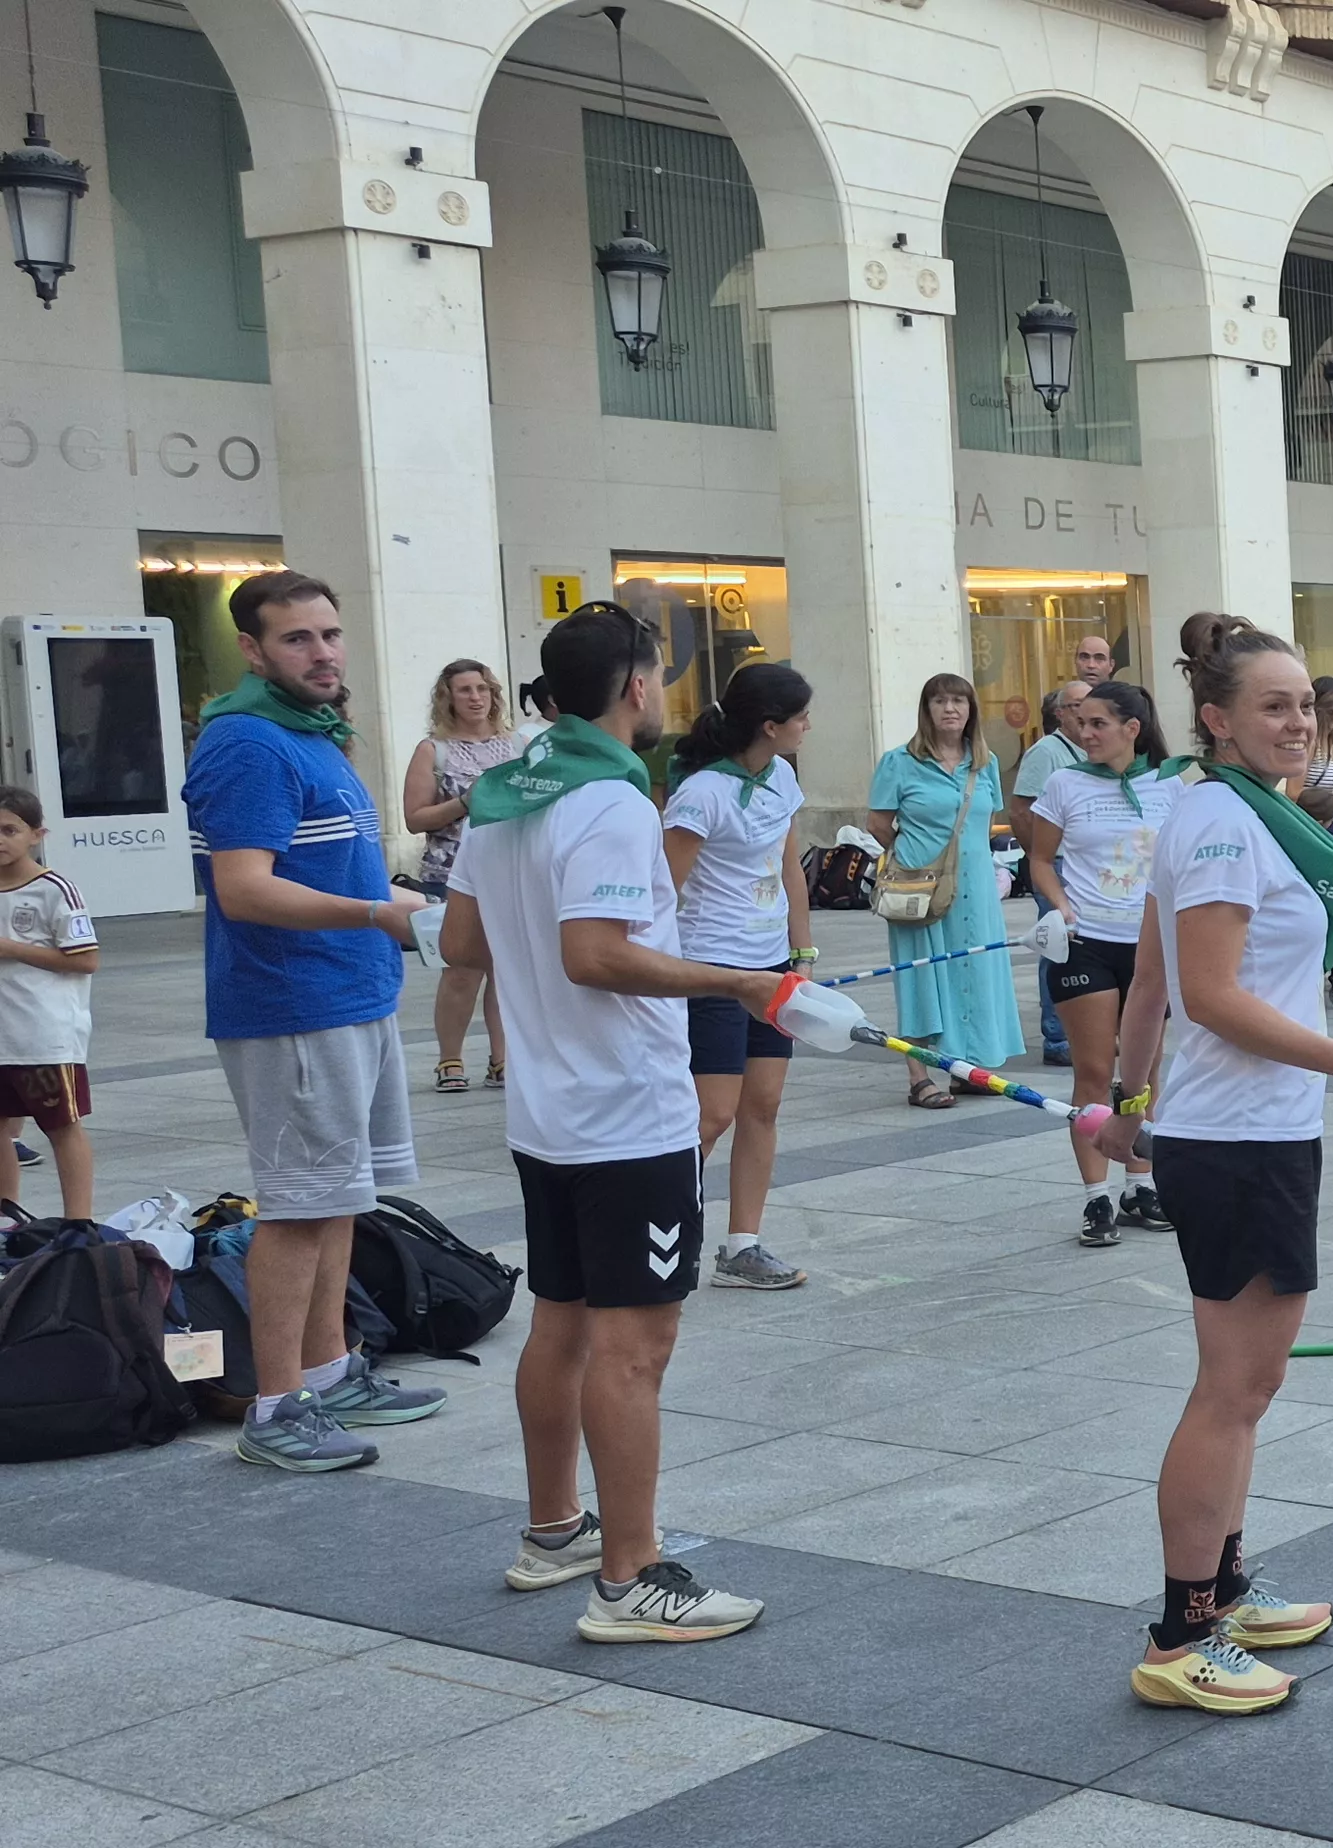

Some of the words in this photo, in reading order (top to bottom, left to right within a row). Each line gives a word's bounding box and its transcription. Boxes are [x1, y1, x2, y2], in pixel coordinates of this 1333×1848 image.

[1024, 497, 1075, 532] DE
[72, 828, 166, 848] HUESCA
[1194, 843, 1246, 861] ATLEET
[592, 885, 647, 898] ATLEET
